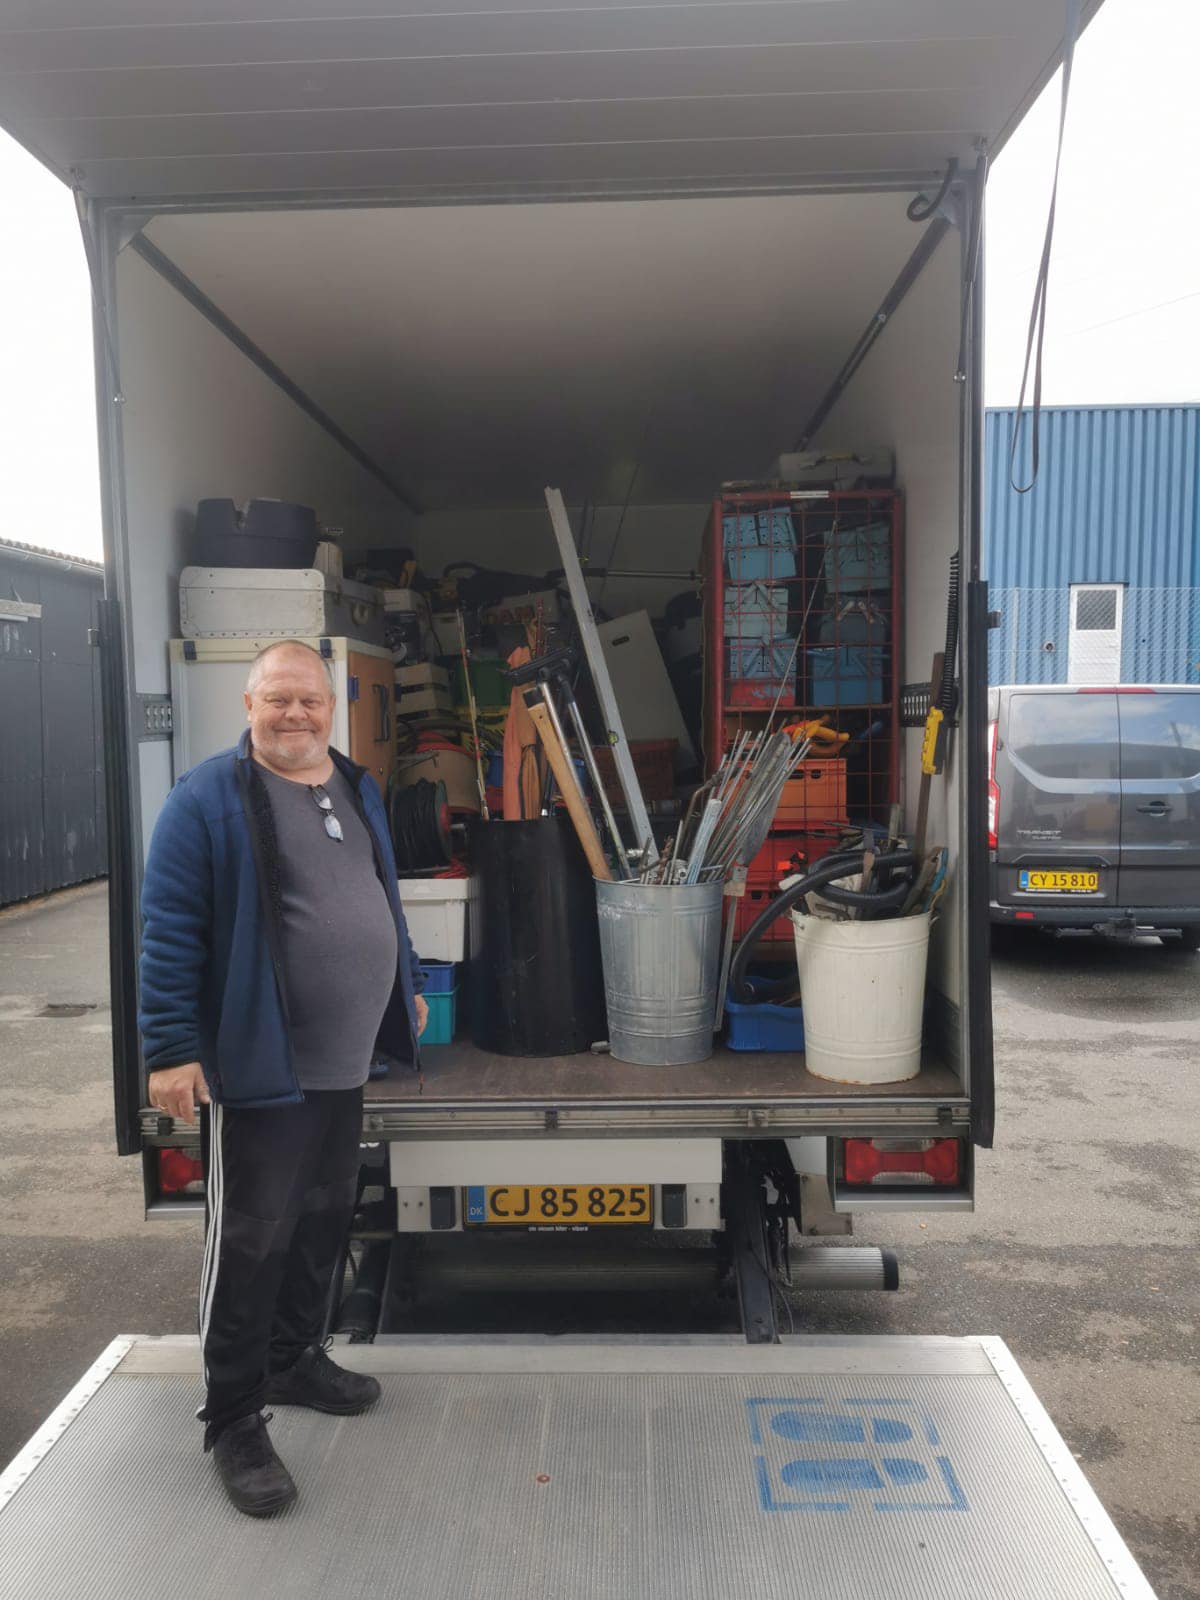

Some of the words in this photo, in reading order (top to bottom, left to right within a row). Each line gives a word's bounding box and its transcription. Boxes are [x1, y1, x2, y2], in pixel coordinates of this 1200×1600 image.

[1030, 874, 1047, 886] CY
[1052, 874, 1067, 886] 15
[1070, 874, 1096, 887] 810
[489, 1187, 531, 1217] CJ
[540, 1187, 578, 1217] 85
[588, 1187, 646, 1217] 825
[469, 1207, 483, 1216] DK
